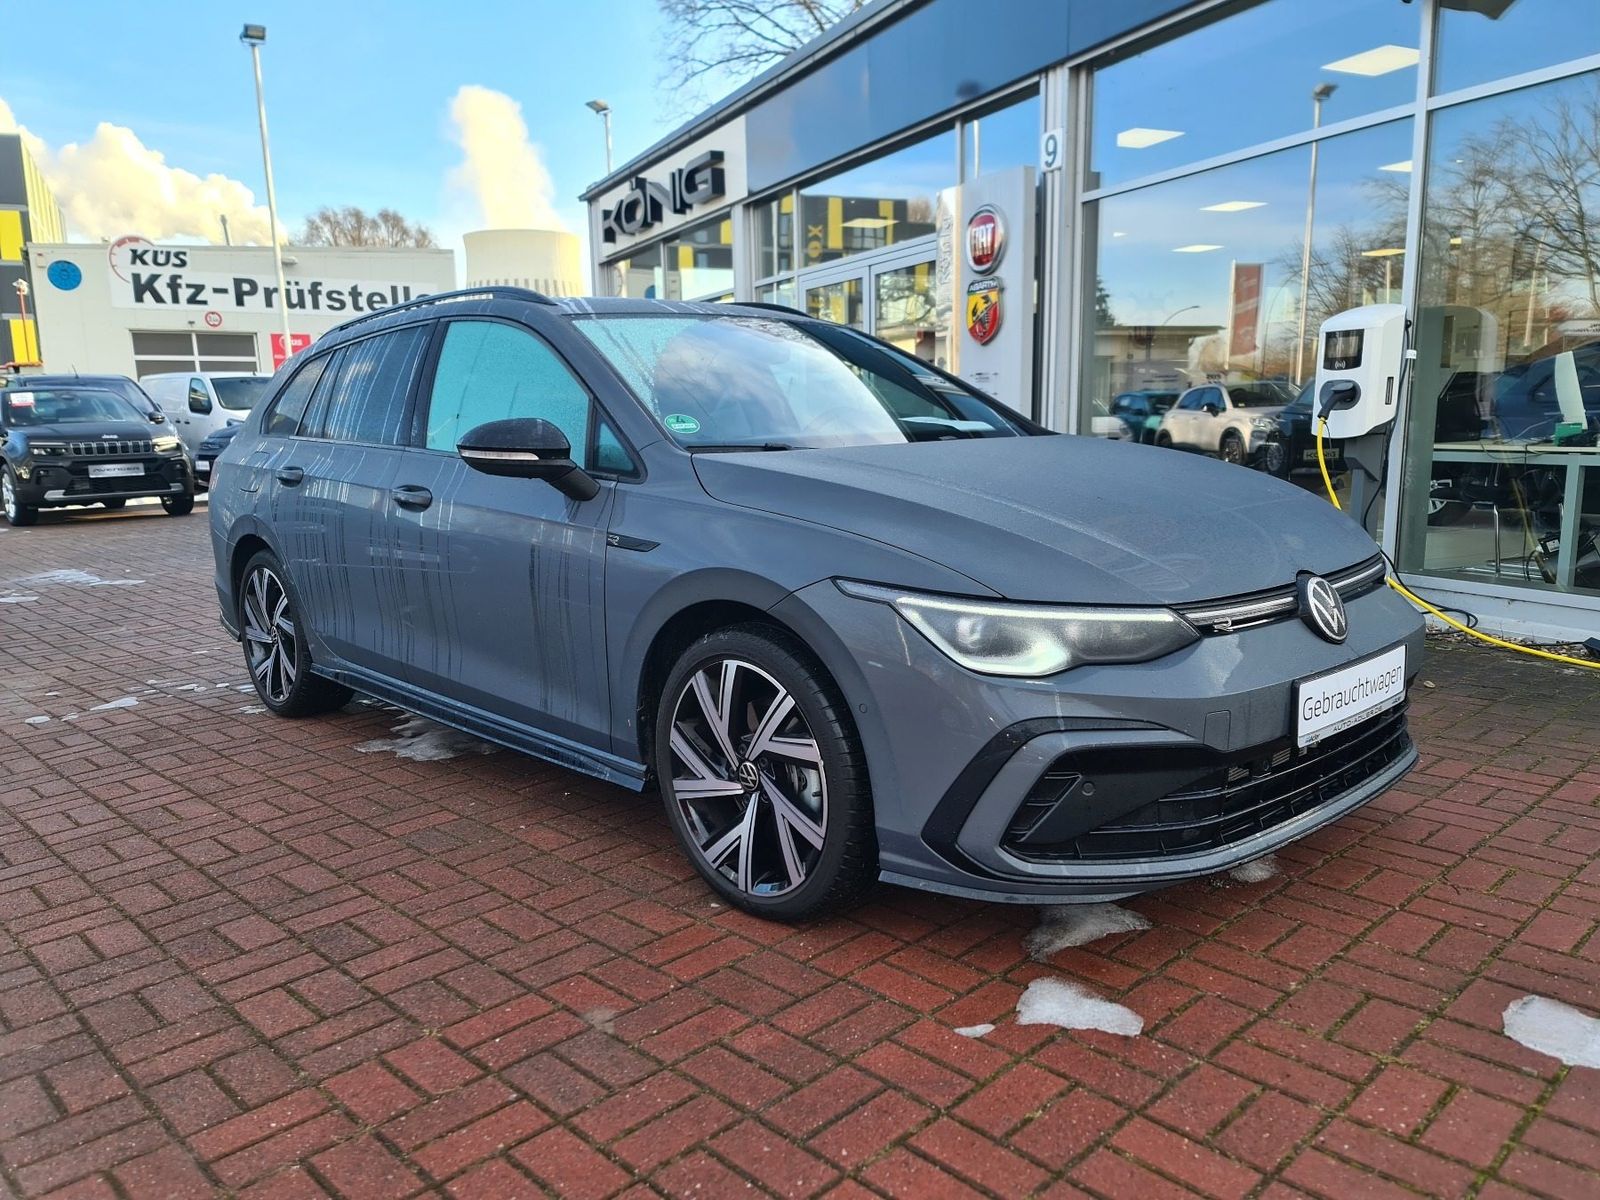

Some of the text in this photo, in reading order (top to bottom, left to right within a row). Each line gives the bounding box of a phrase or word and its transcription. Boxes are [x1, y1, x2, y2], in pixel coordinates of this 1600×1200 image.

[1045, 134, 1058, 168] 9
[602, 149, 725, 244] KÖNIG
[129, 248, 188, 268] KÜS
[971, 223, 995, 259] FIAT
[131, 272, 431, 312] Kfz-Prüfstell
[1303, 666, 1402, 721] Gebrauchtwagen
